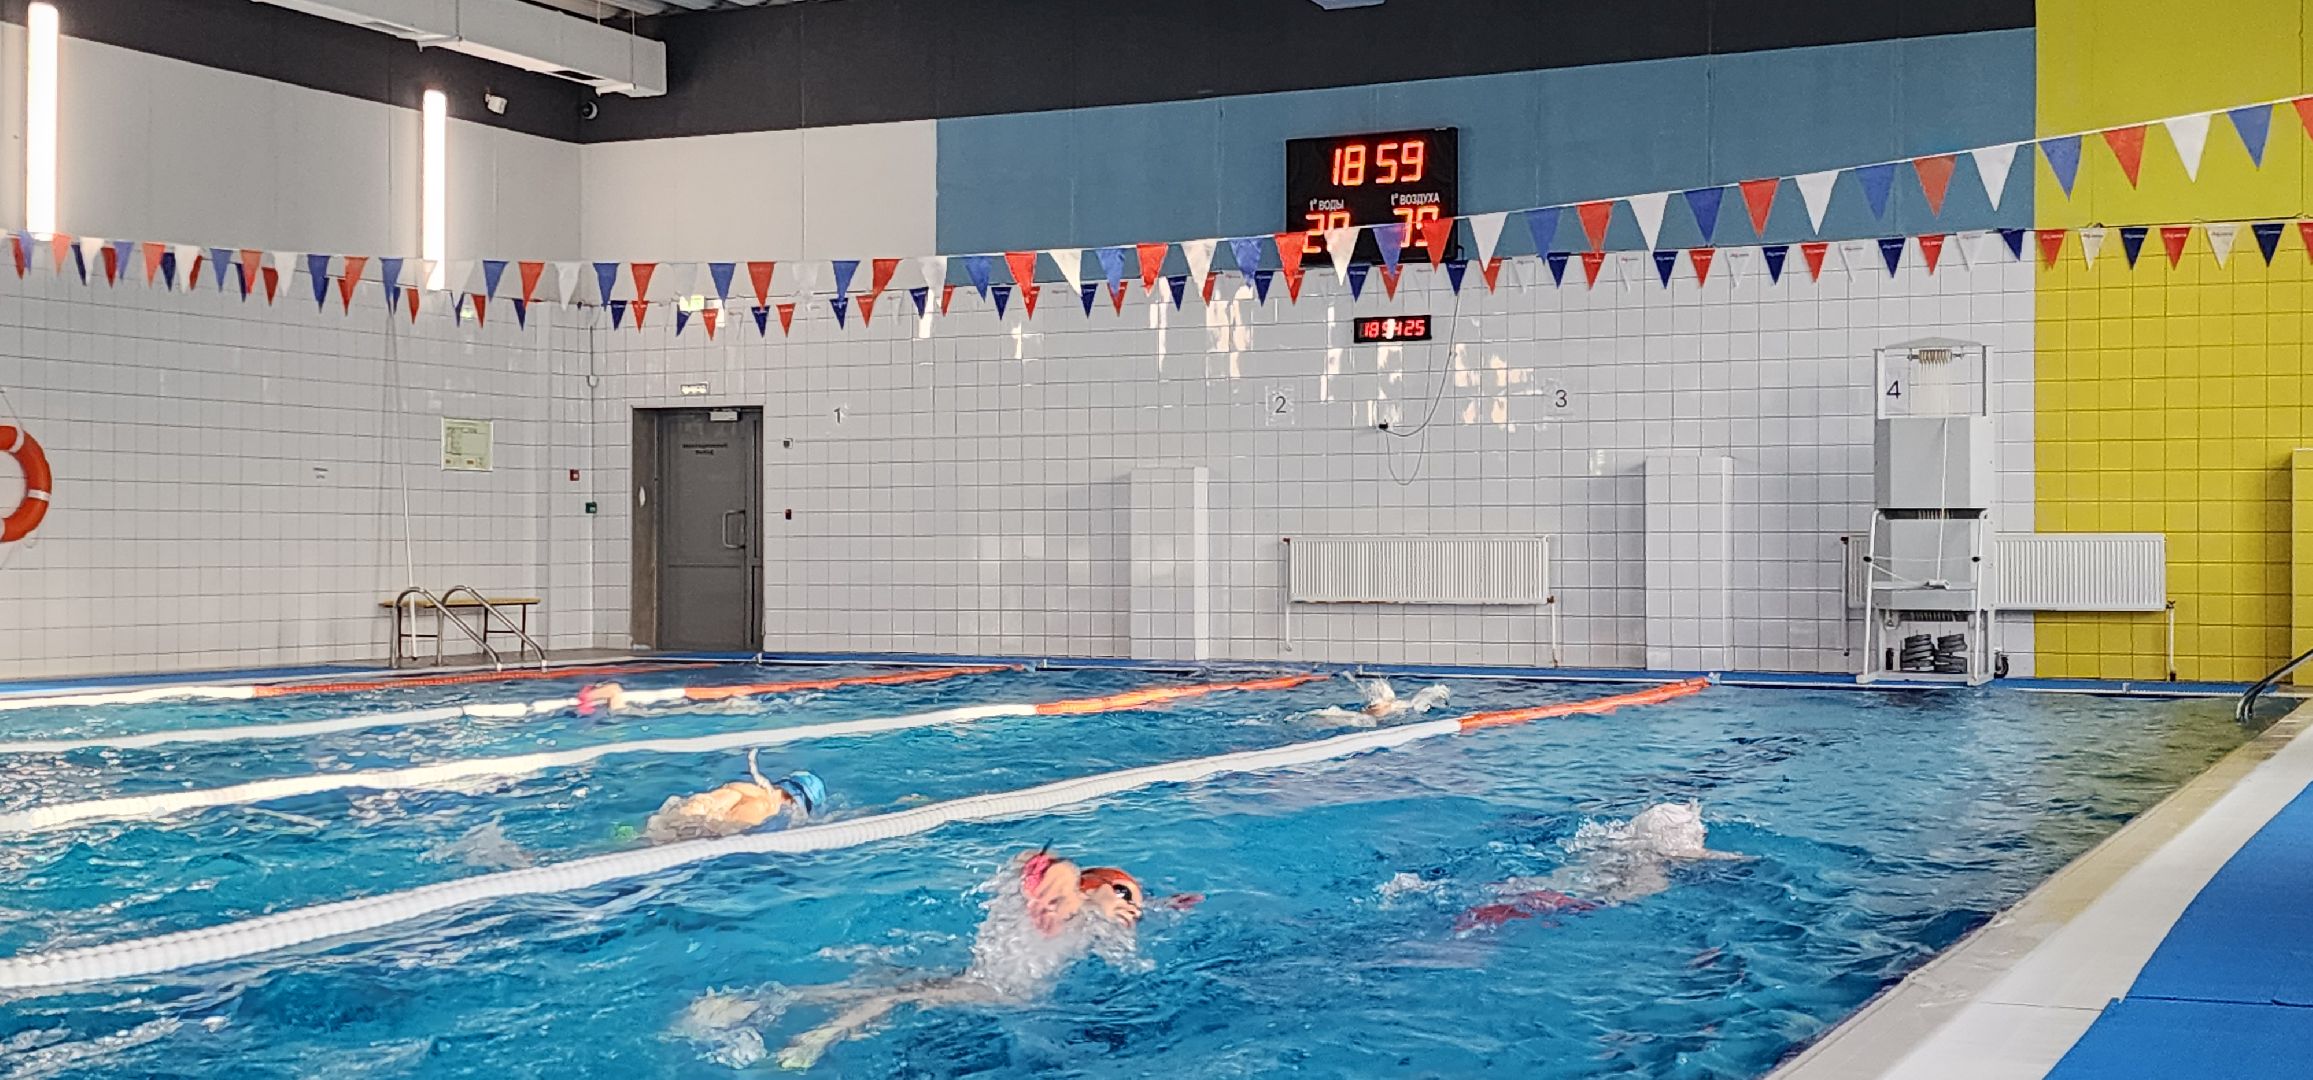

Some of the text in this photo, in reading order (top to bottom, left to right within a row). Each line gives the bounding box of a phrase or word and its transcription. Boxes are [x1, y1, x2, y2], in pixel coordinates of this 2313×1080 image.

[1332, 140, 1424, 187] 18 59
[1318, 199, 1345, 211] ВОДЫ
[1400, 192, 1441, 205] ВОЗДУХА
[1886, 379, 1901, 399] 4
[1275, 395, 1287, 413] 2
[1555, 389, 1567, 408] 3
[833, 407, 841, 425] 1
